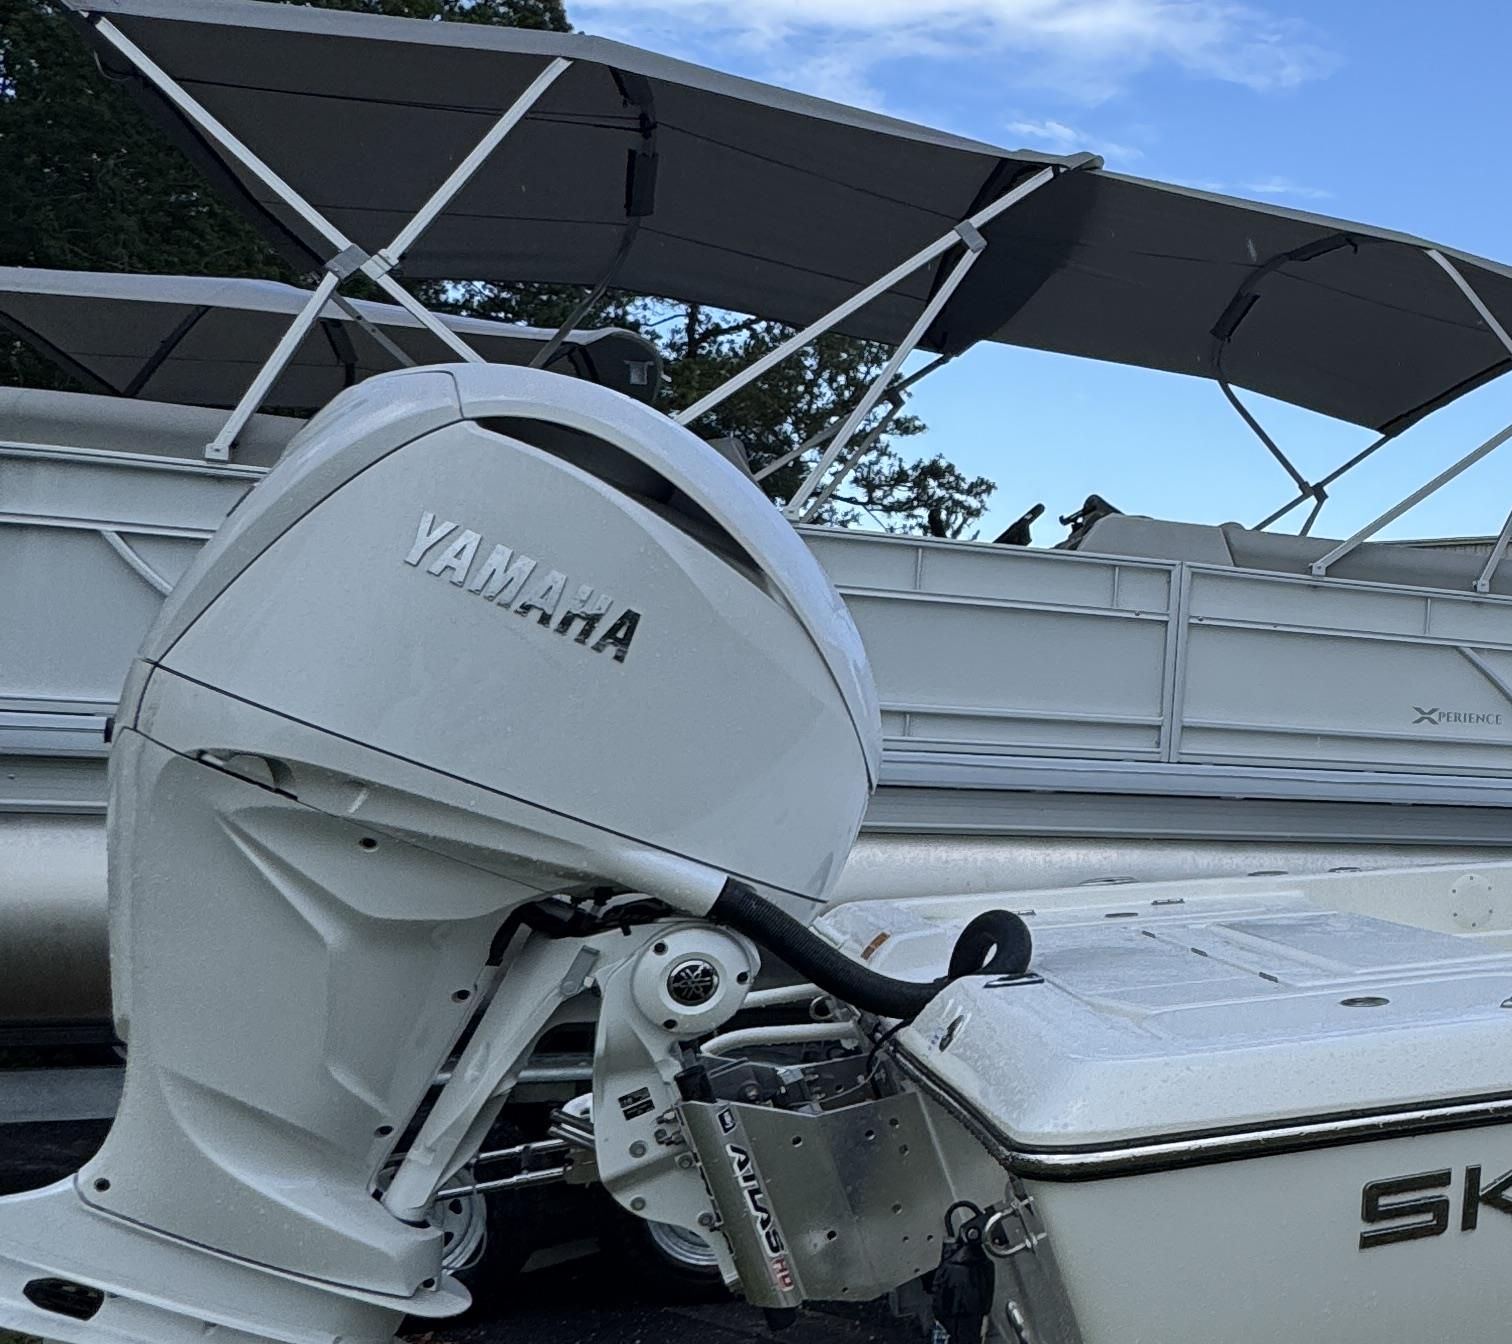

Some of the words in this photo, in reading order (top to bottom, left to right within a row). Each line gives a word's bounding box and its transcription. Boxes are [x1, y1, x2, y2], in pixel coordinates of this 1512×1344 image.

[403, 510, 642, 664] YAMAHA
[1412, 706, 1503, 725] XPERIENCE
[726, 1143, 787, 1256] ATLAS
